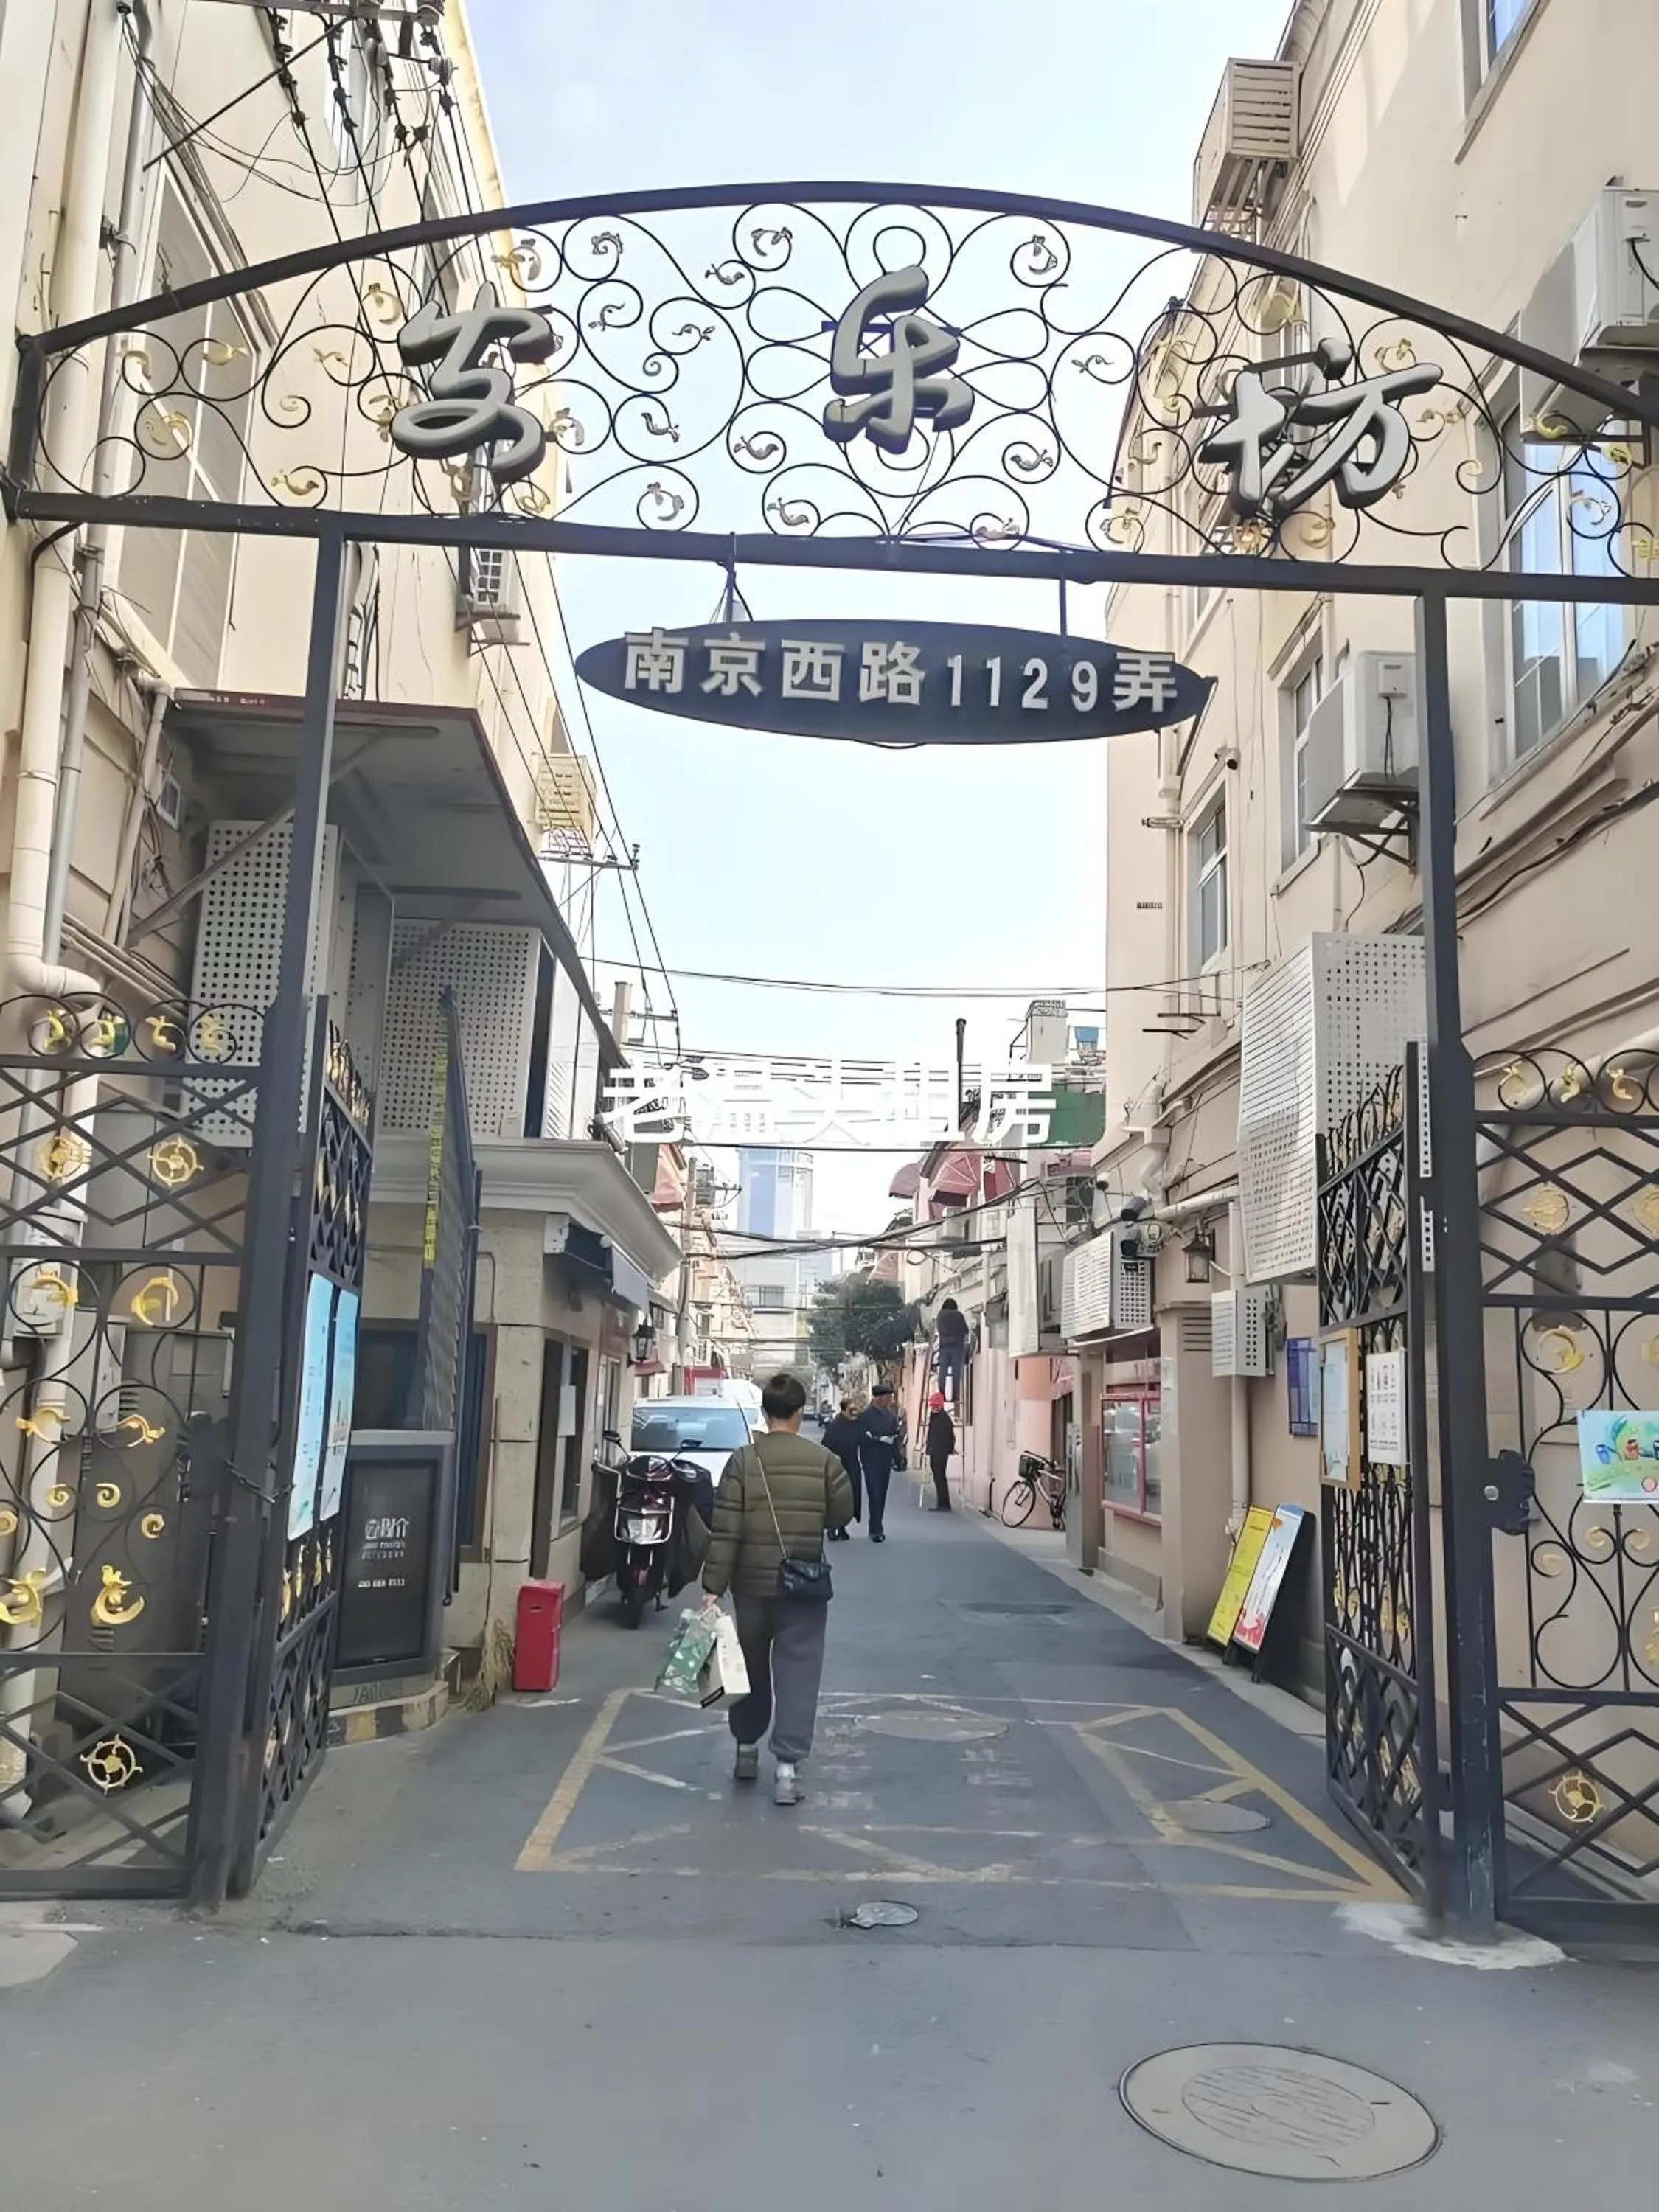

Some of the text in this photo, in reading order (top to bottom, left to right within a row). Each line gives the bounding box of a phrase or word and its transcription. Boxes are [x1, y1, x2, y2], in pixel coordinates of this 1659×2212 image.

[625, 627, 1178, 712] 南京西路1129弄
